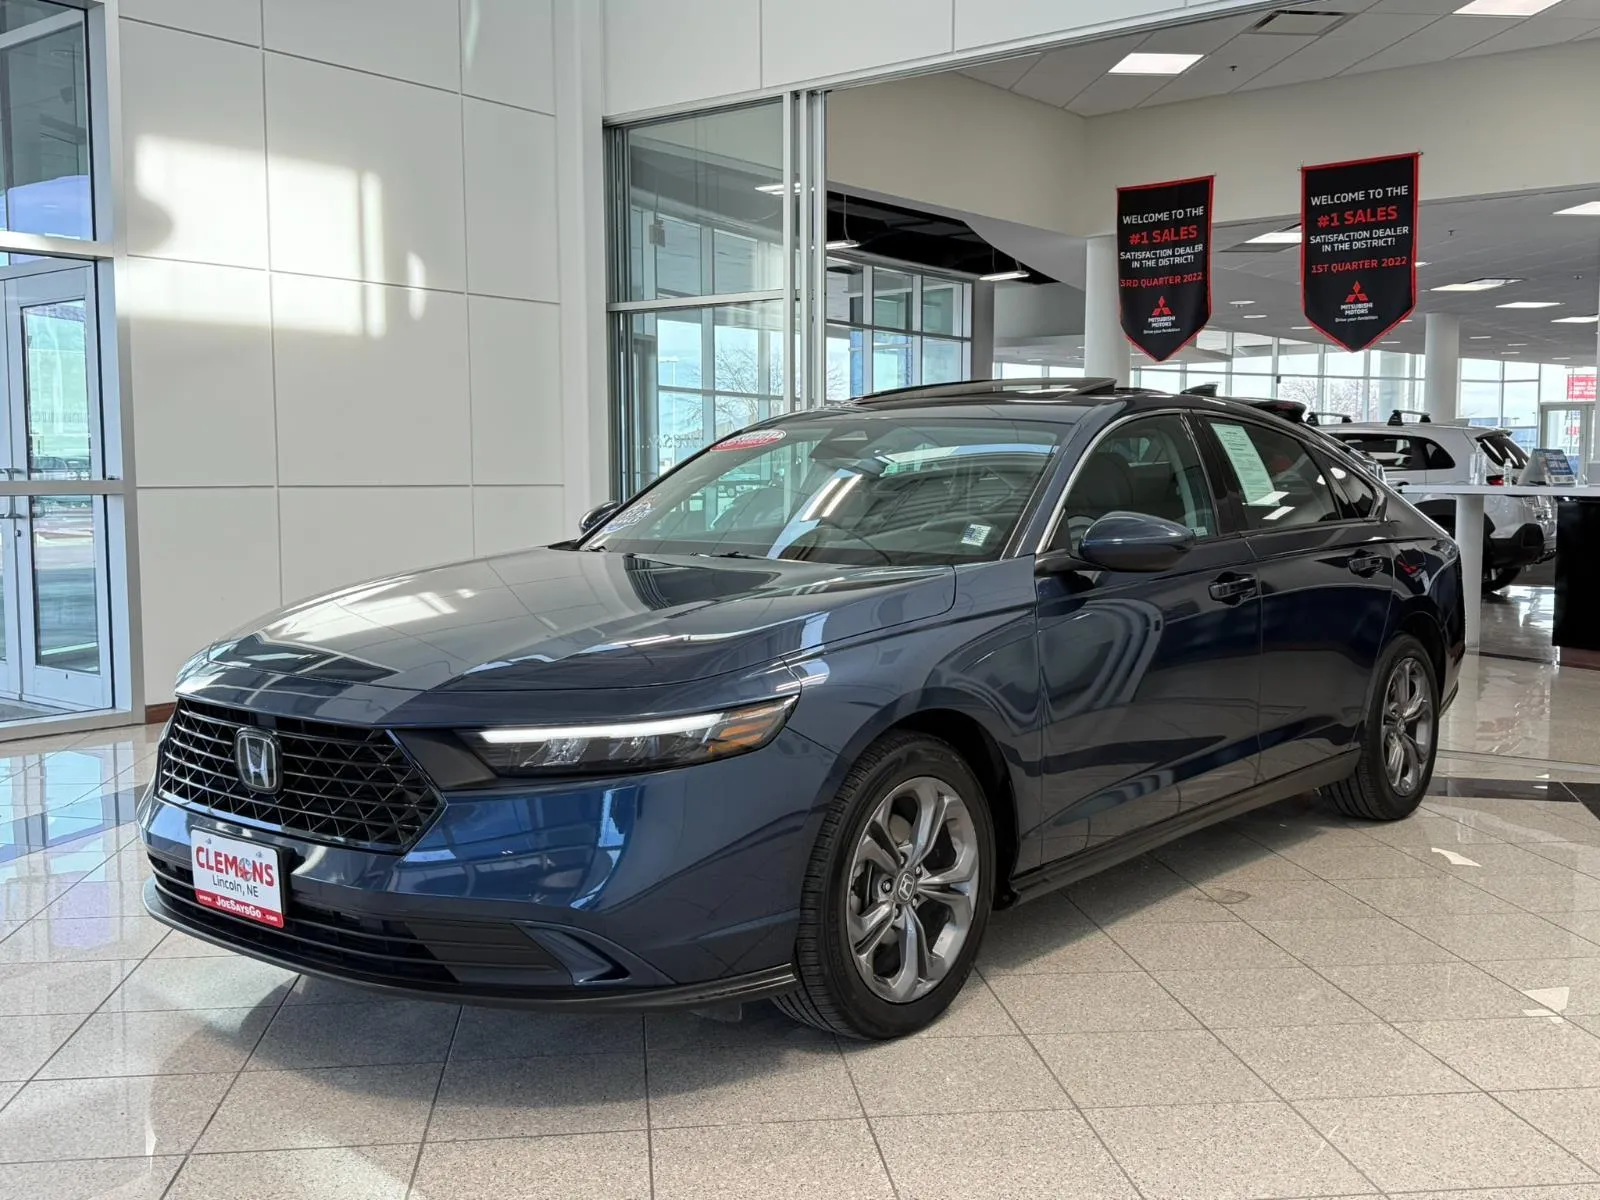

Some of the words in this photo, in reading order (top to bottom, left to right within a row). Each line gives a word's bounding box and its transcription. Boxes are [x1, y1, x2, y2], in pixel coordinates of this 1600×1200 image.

[1311, 190, 1365, 206] WELCOME
[1368, 188, 1383, 200] TO
[1385, 185, 1408, 197] THE
[1122, 211, 1170, 225] WELCOME
[1171, 208, 1184, 219] TO
[1185, 206, 1204, 218] THE
[1317, 213, 1340, 227] #1
[1344, 206, 1397, 225] SALES
[1129, 232, 1148, 244] #1
[1152, 225, 1197, 243] SALES
[1310, 230, 1370, 244] SATISFACTION
[1372, 226, 1409, 239] DEALER
[1120, 248, 1173, 260] SATISFACTION
[1174, 244, 1204, 256] DEALER
[1322, 243, 1331, 252] IN
[1333, 241, 1350, 251] THE
[1352, 238, 1396, 250] DISTRICT!
[1131, 260, 1140, 269] IN
[1141, 258, 1157, 268] THE
[1158, 255, 1195, 267] DISTRICT!
[1311, 264, 1329, 273] 1ST
[1331, 259, 1378, 273] QUARTER
[1381, 256, 1407, 268] 2022
[1120, 278, 1139, 288] 3RD
[1141, 274, 1181, 288] QUARTER
[1183, 272, 1203, 283] 2022
[1340, 302, 1373, 310] MITSUBISHI
[1344, 308, 1369, 316] MOTORS
[195, 846, 275, 888] CLEMONS
[212, 874, 246, 896] Lincoln,
[246, 884, 259, 898] NE
